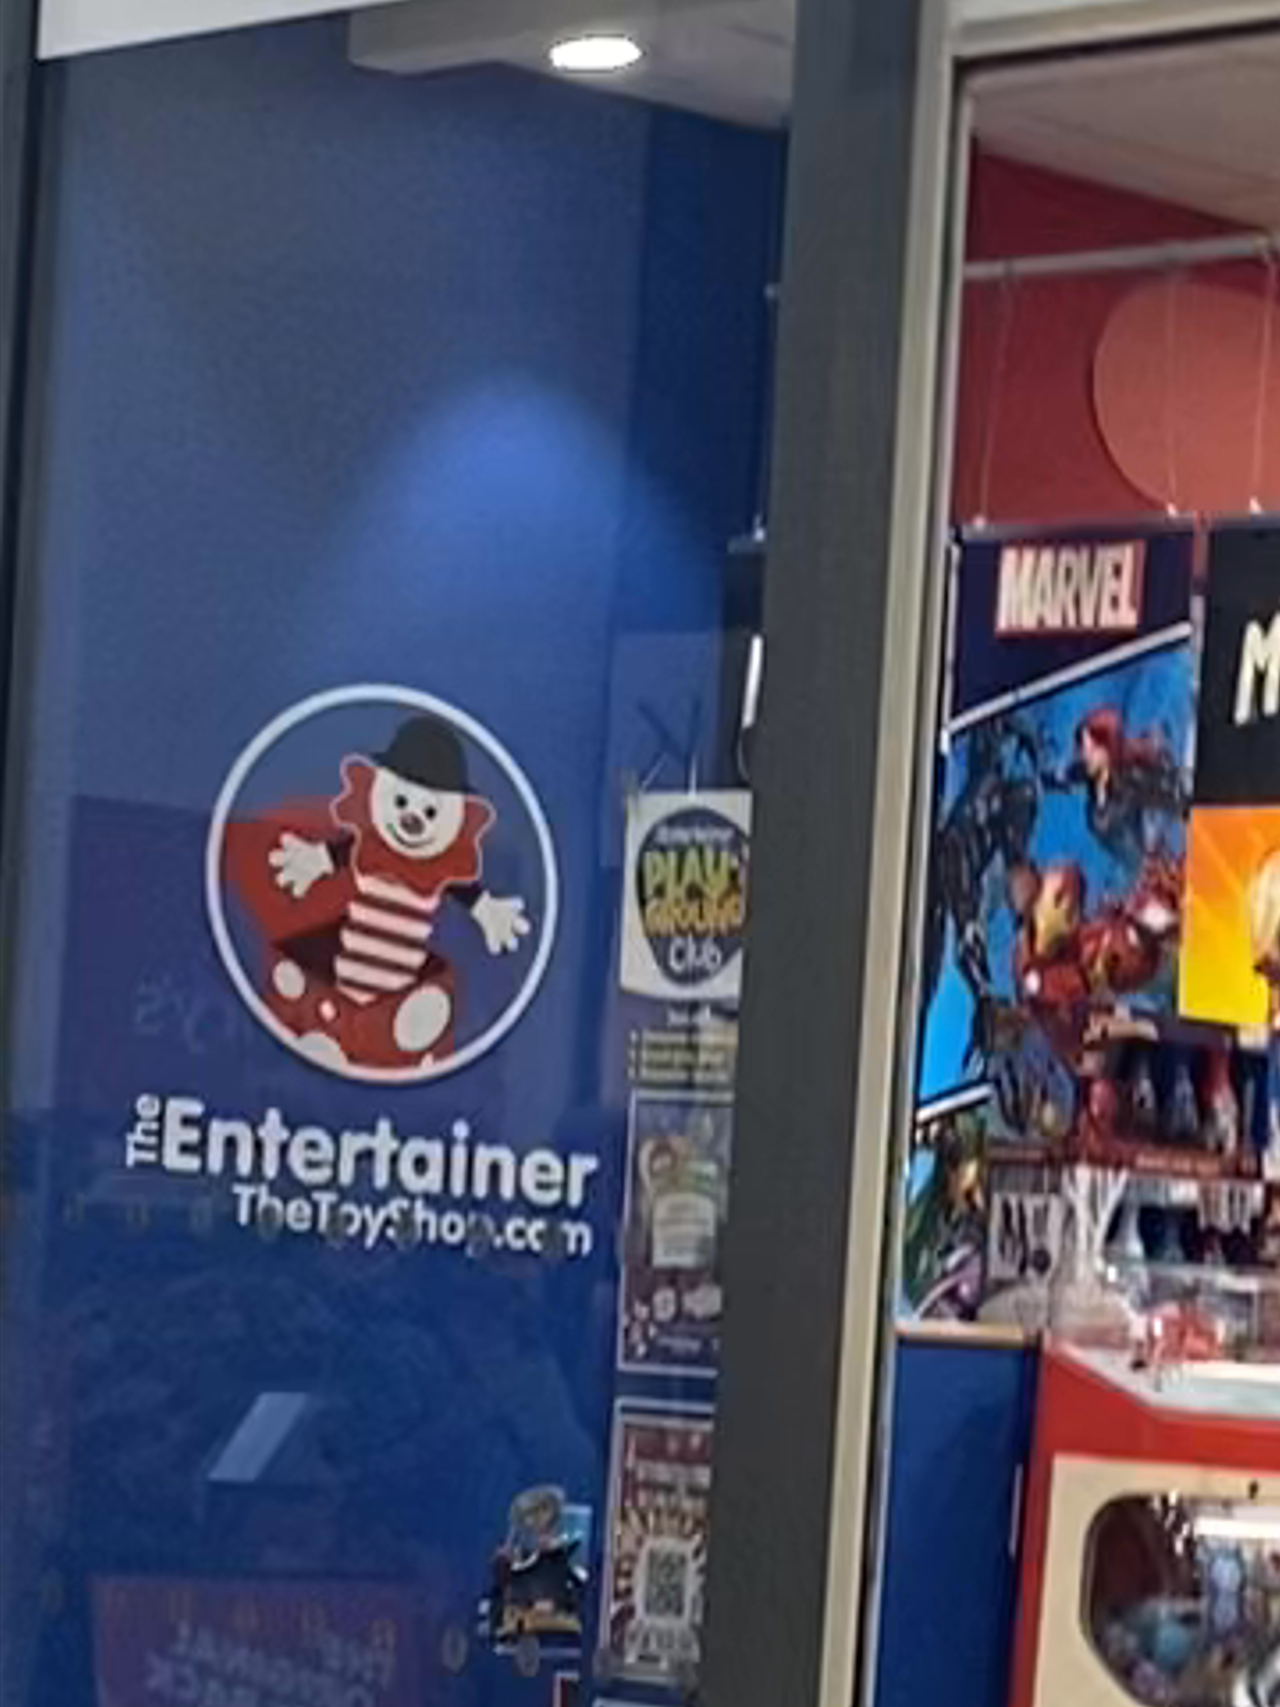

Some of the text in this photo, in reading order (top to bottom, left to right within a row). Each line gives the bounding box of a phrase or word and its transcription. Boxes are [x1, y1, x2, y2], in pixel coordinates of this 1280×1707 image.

[996, 541, 1142, 631] MARVEL
[126, 1094, 598, 1207] The Entertainer
[233, 1184, 593, 1257] TheToyShop.com
